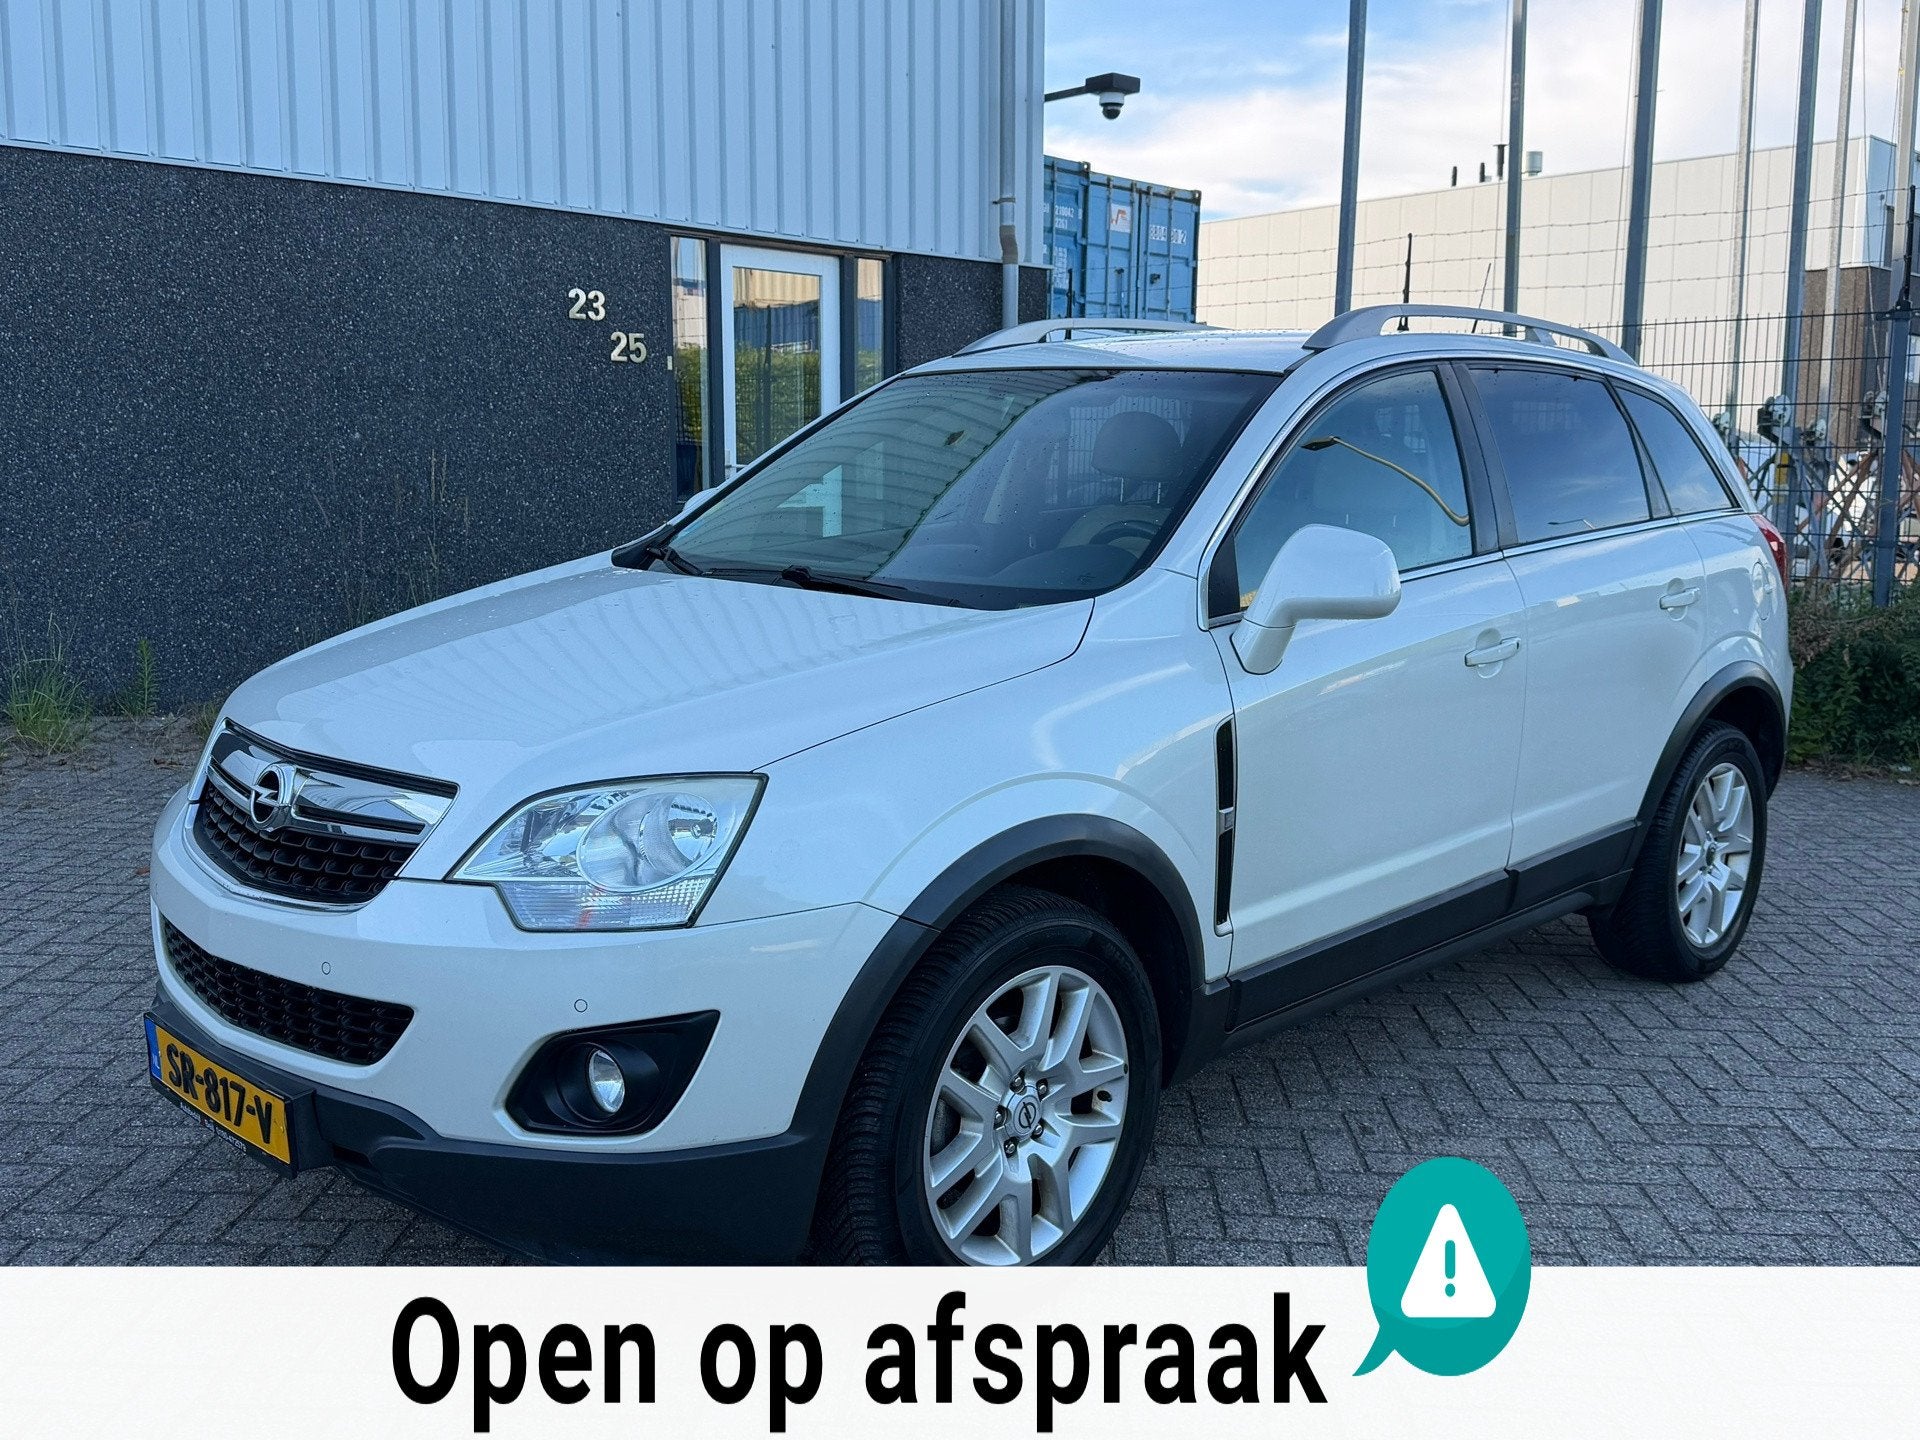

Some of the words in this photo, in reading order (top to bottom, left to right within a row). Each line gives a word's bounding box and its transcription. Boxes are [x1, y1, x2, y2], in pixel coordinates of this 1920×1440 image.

[568, 288, 606, 321] 23
[610, 331, 647, 363] 25
[166, 1043, 273, 1145] SR-817-V
